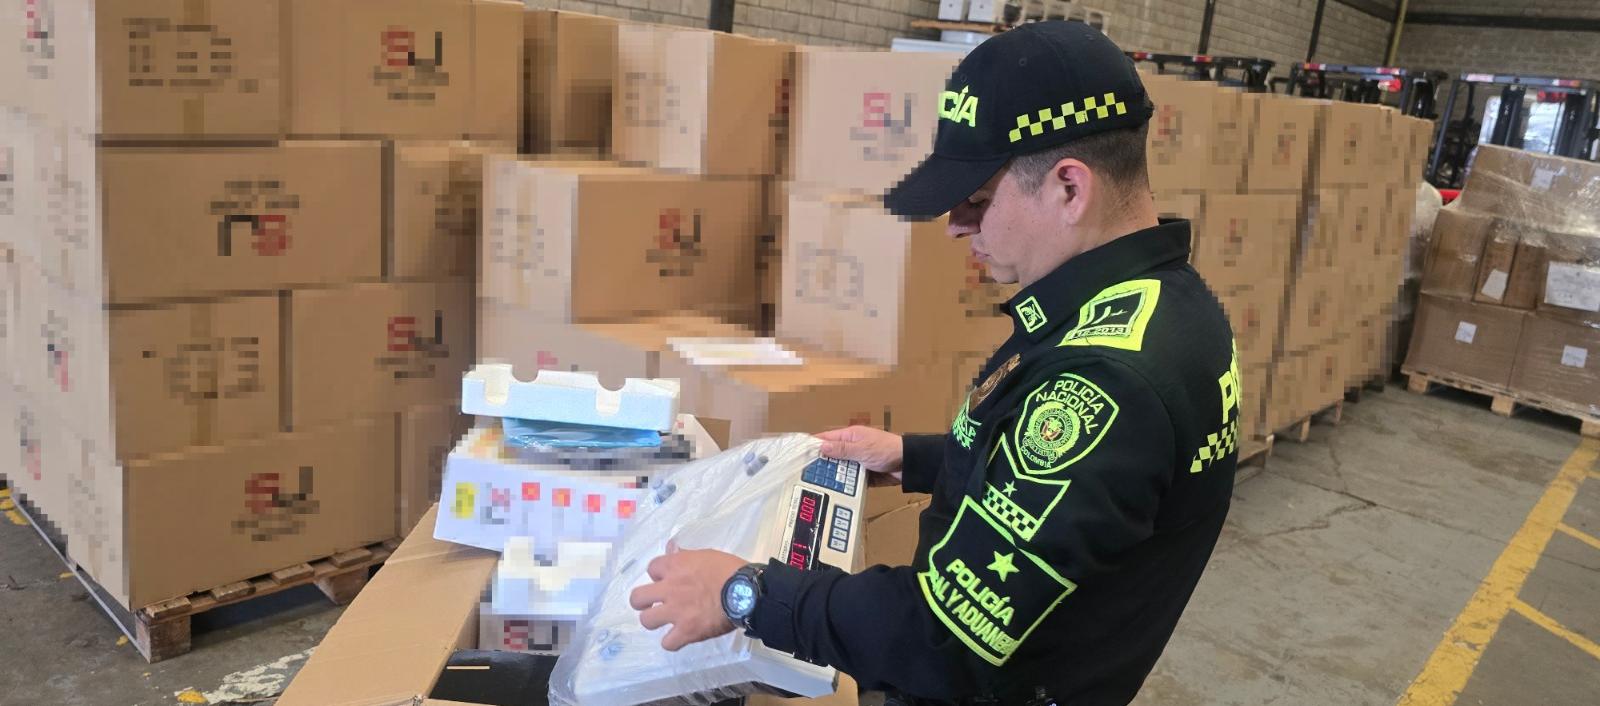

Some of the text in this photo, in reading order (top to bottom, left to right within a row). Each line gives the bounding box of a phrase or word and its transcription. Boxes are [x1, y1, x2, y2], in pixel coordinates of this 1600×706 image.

[1036, 391, 1099, 435] NACIONAL
[1021, 445, 1052, 468] COLOMBIA
[946, 559, 1015, 626] POLICÍA
